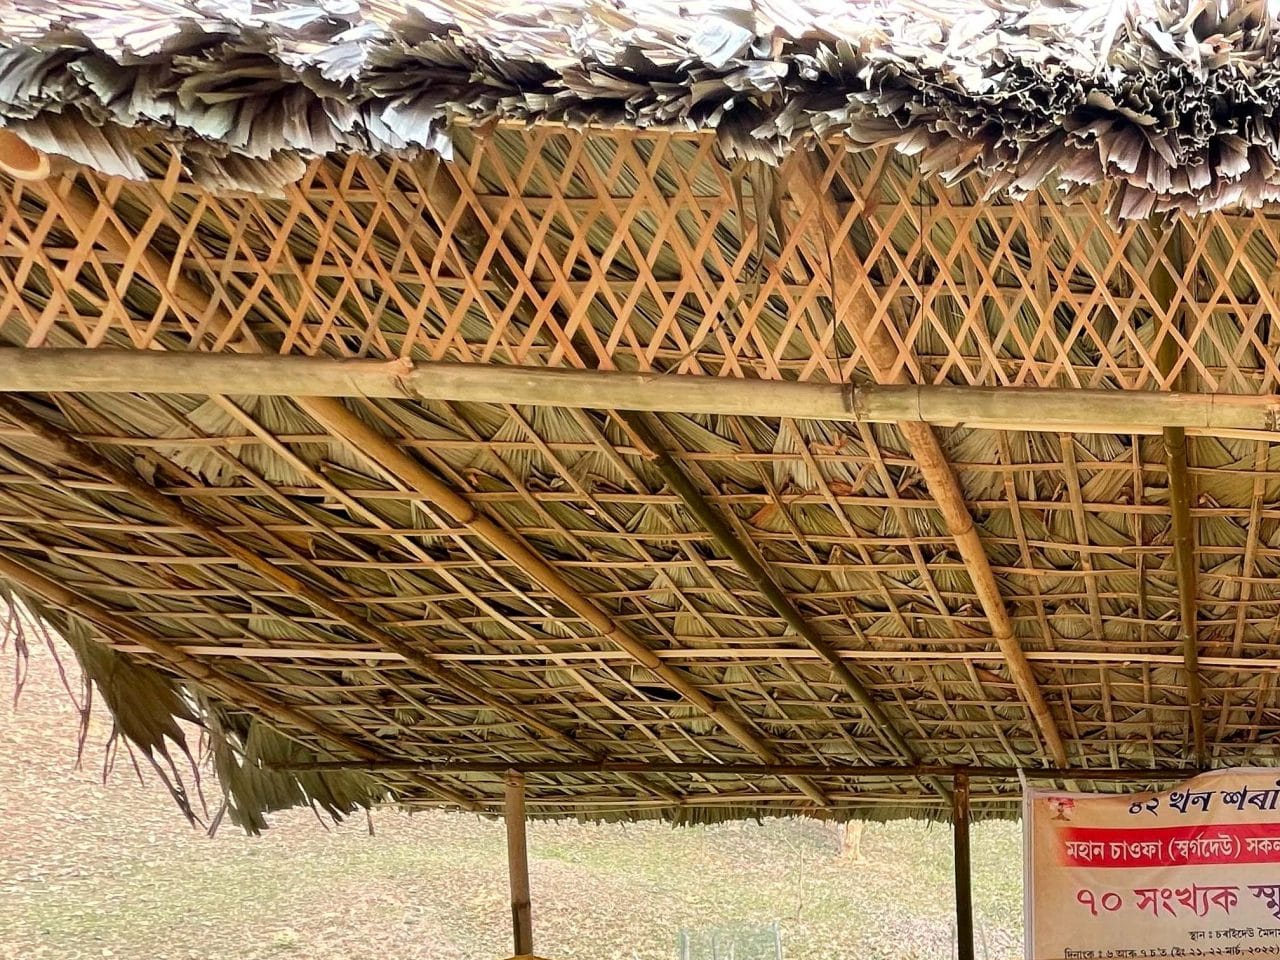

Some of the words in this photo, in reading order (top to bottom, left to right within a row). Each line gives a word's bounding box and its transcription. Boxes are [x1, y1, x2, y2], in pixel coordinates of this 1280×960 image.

[1169, 789, 1216, 813] খন
[1066, 840, 1104, 861] মহান
[1110, 840, 1162, 861] চাওফা
[1076, 889, 1122, 917] ৭০
[1134, 883, 1240, 917] সংখ্যক
